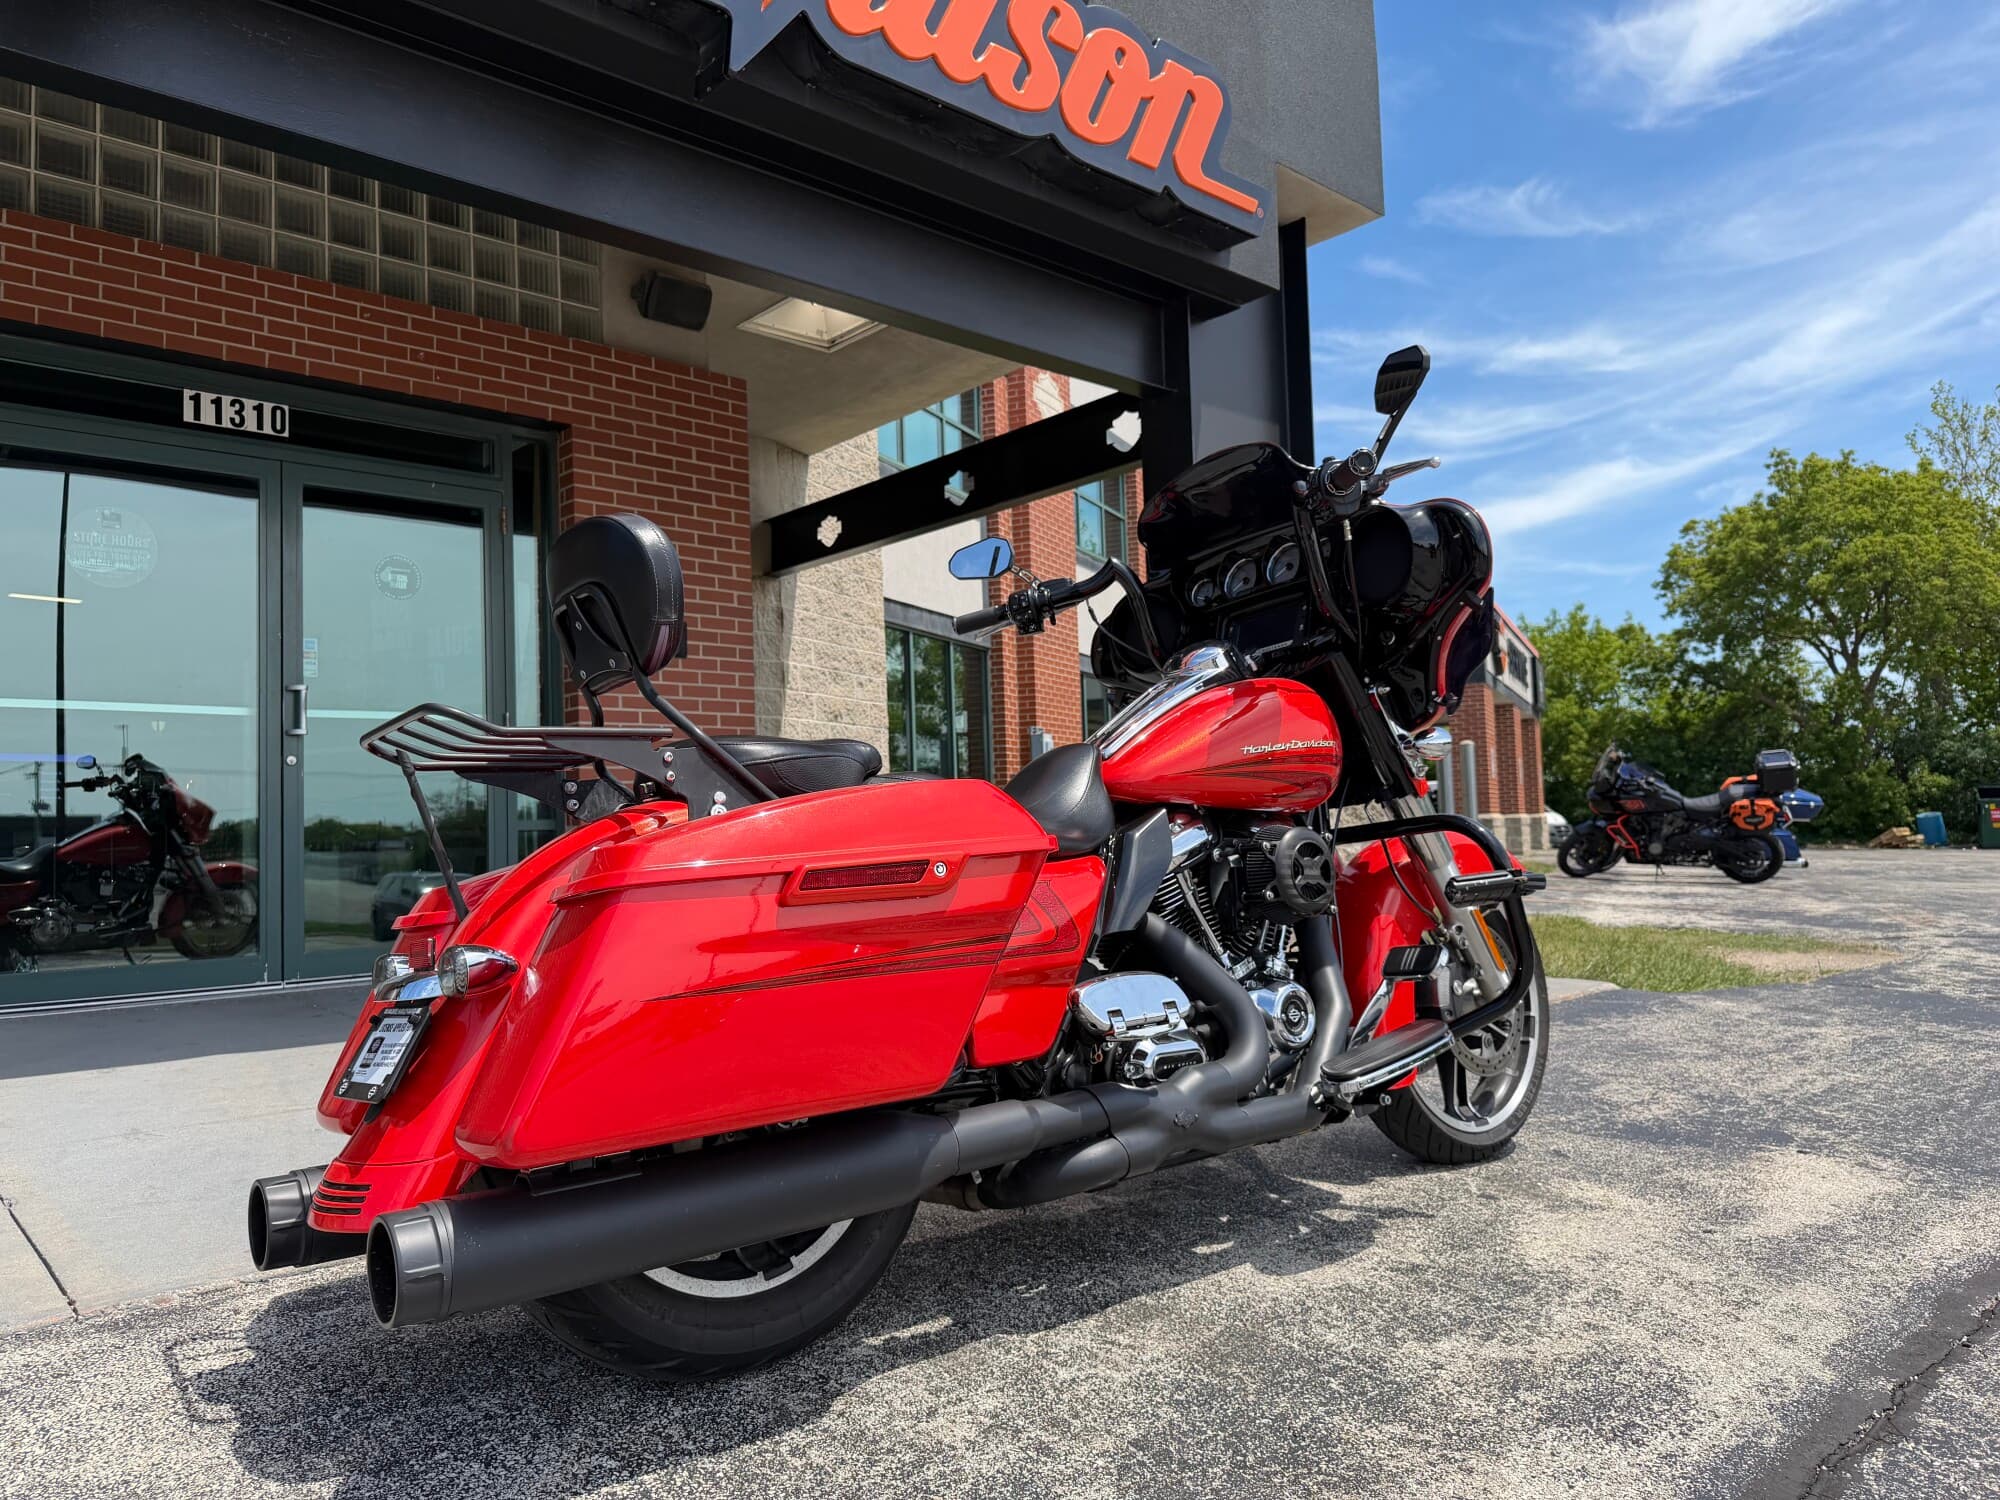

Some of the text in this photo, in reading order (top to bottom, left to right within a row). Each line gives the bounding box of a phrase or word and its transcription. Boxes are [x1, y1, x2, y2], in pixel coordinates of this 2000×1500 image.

[188, 392, 287, 435] 11310
[111, 533, 150, 548] HOURS
[1240, 738, 1336, 755] Harley-Davidson
